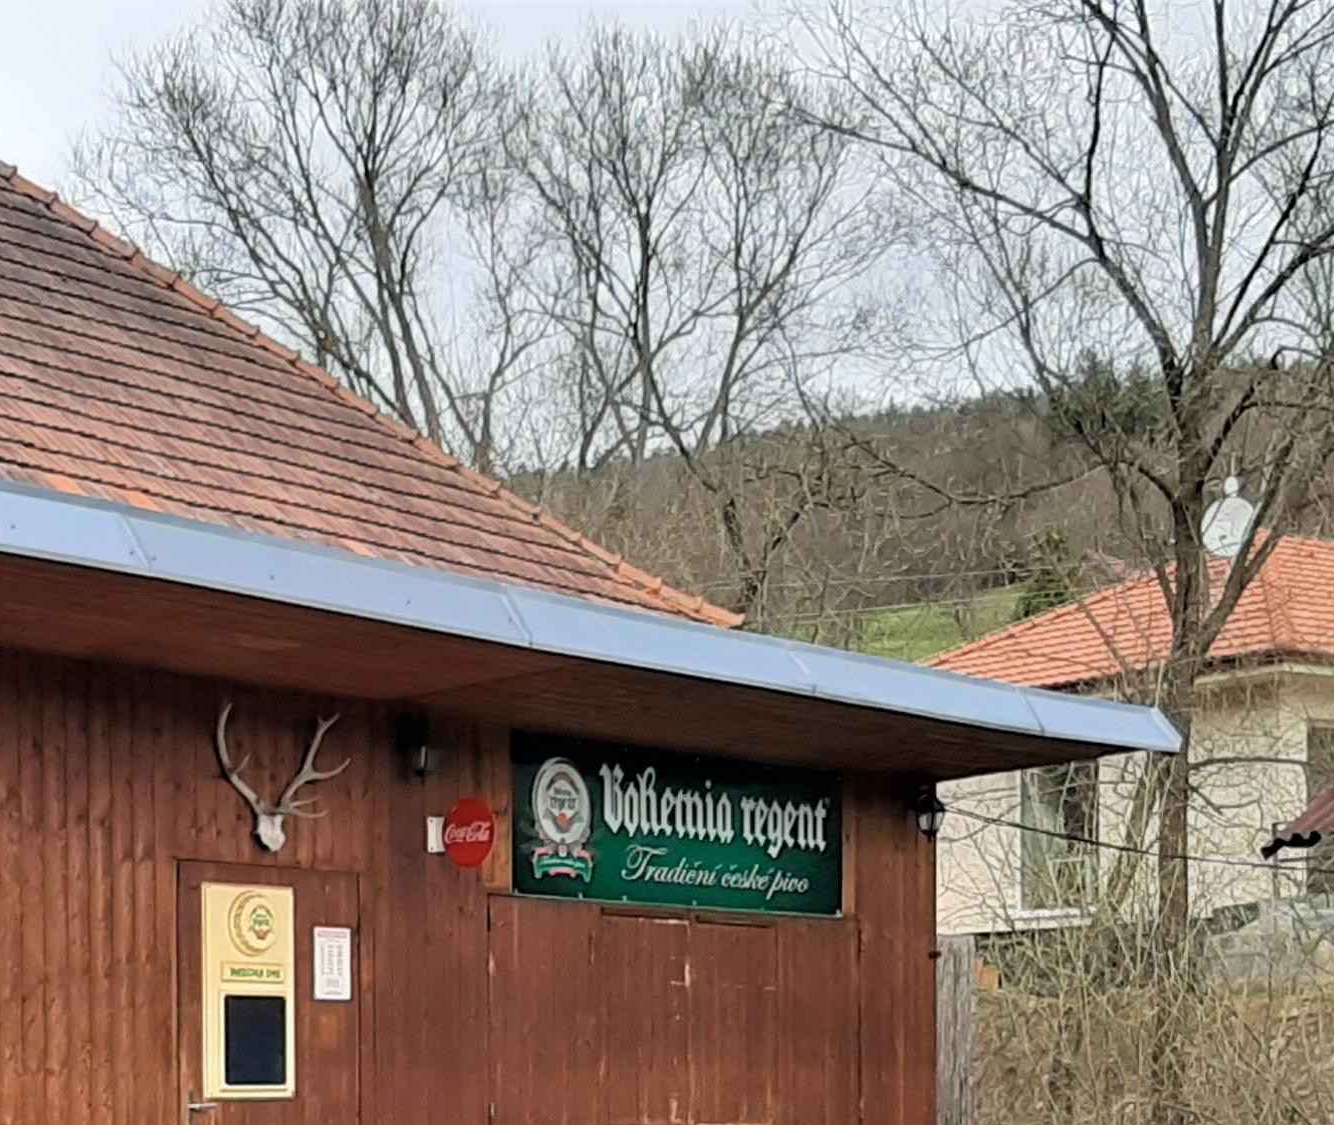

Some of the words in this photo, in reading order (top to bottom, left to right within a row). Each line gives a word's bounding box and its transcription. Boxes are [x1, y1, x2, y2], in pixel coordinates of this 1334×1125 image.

[599, 762, 734, 844] Bohemia
[740, 796, 827, 859] regent
[621, 844, 723, 887] Tradiční
[721, 864, 775, 890] české
[765, 870, 810, 900] pivo
